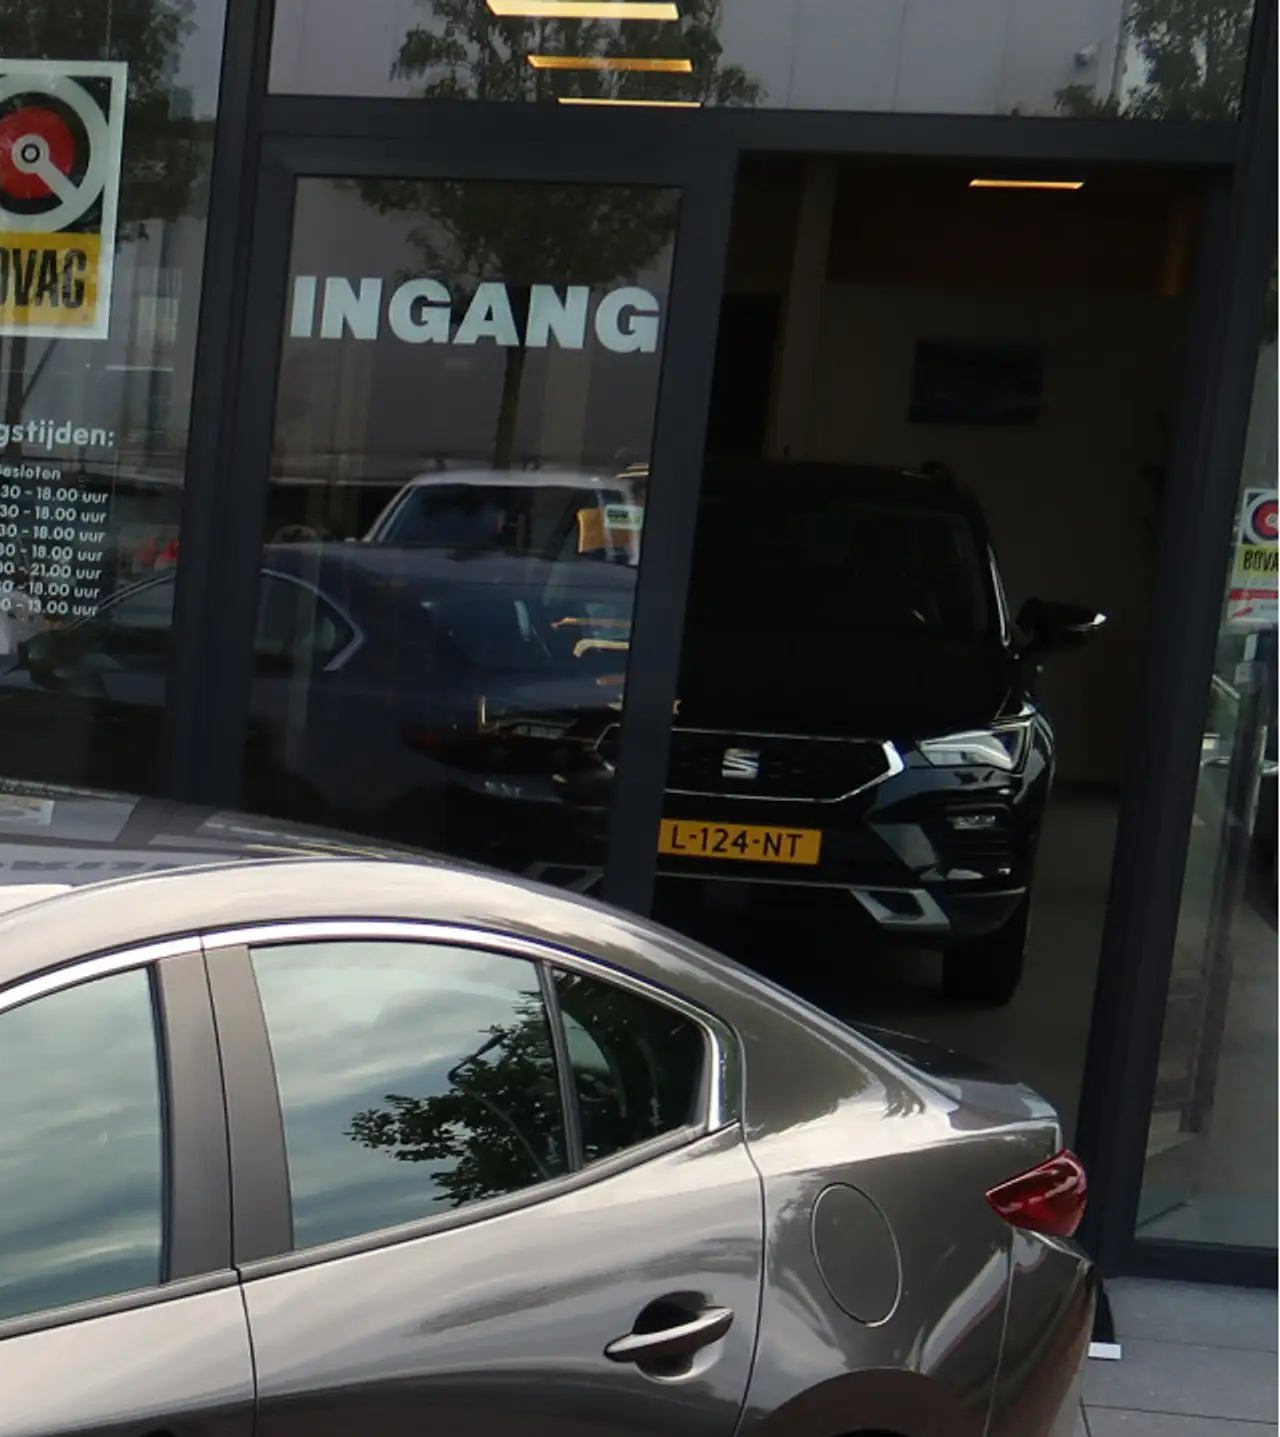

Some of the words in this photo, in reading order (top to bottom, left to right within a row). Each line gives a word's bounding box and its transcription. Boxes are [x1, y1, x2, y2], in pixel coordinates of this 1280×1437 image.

[290, 275, 660, 354] INGANG
[37, 487, 78, 502] 18.00
[82, 492, 108, 504] uur
[35, 506, 76, 521] 18.00
[81, 511, 107, 523] uur
[33, 525, 74, 541] 18.00
[79, 531, 106, 543] uur
[31, 545, 73, 561] 18.00
[77, 551, 103, 563] uur
[30, 563, 71, 578] 21.00
[76, 569, 102, 580] uur
[29, 583, 70, 597] 18.00
[74, 588, 100, 599] uur
[28, 599, 68, 614] 13.00
[72, 604, 98, 616] uur
[671, 825, 804, 858] L-124-NT
